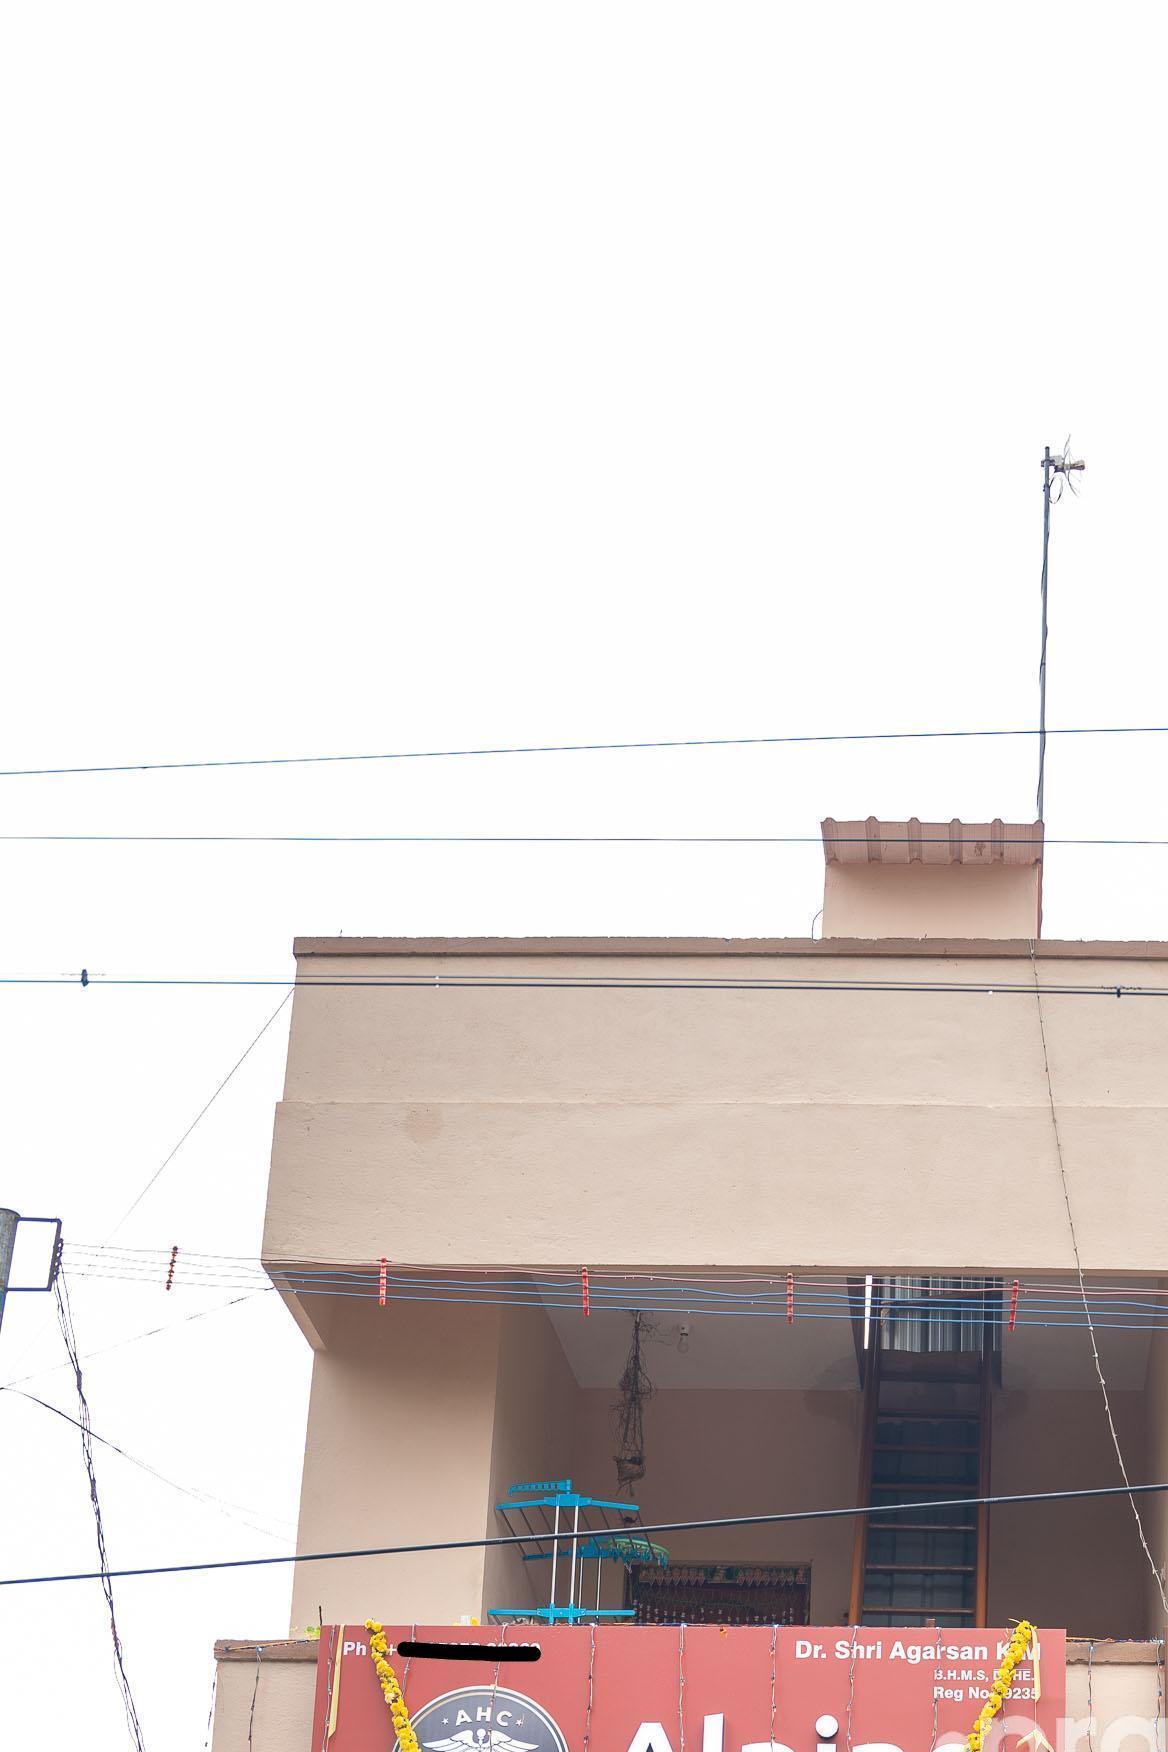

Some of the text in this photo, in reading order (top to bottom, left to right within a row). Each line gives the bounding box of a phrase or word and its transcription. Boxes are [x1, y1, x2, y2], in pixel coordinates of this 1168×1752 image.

[795, 1640, 827, 1659] Dr.
[834, 1640, 882, 1660] Shri
[889, 1640, 988, 1664] Agarsan
[933, 1686, 963, 1702] Reg
[455, 1706, 513, 1727] AHC
